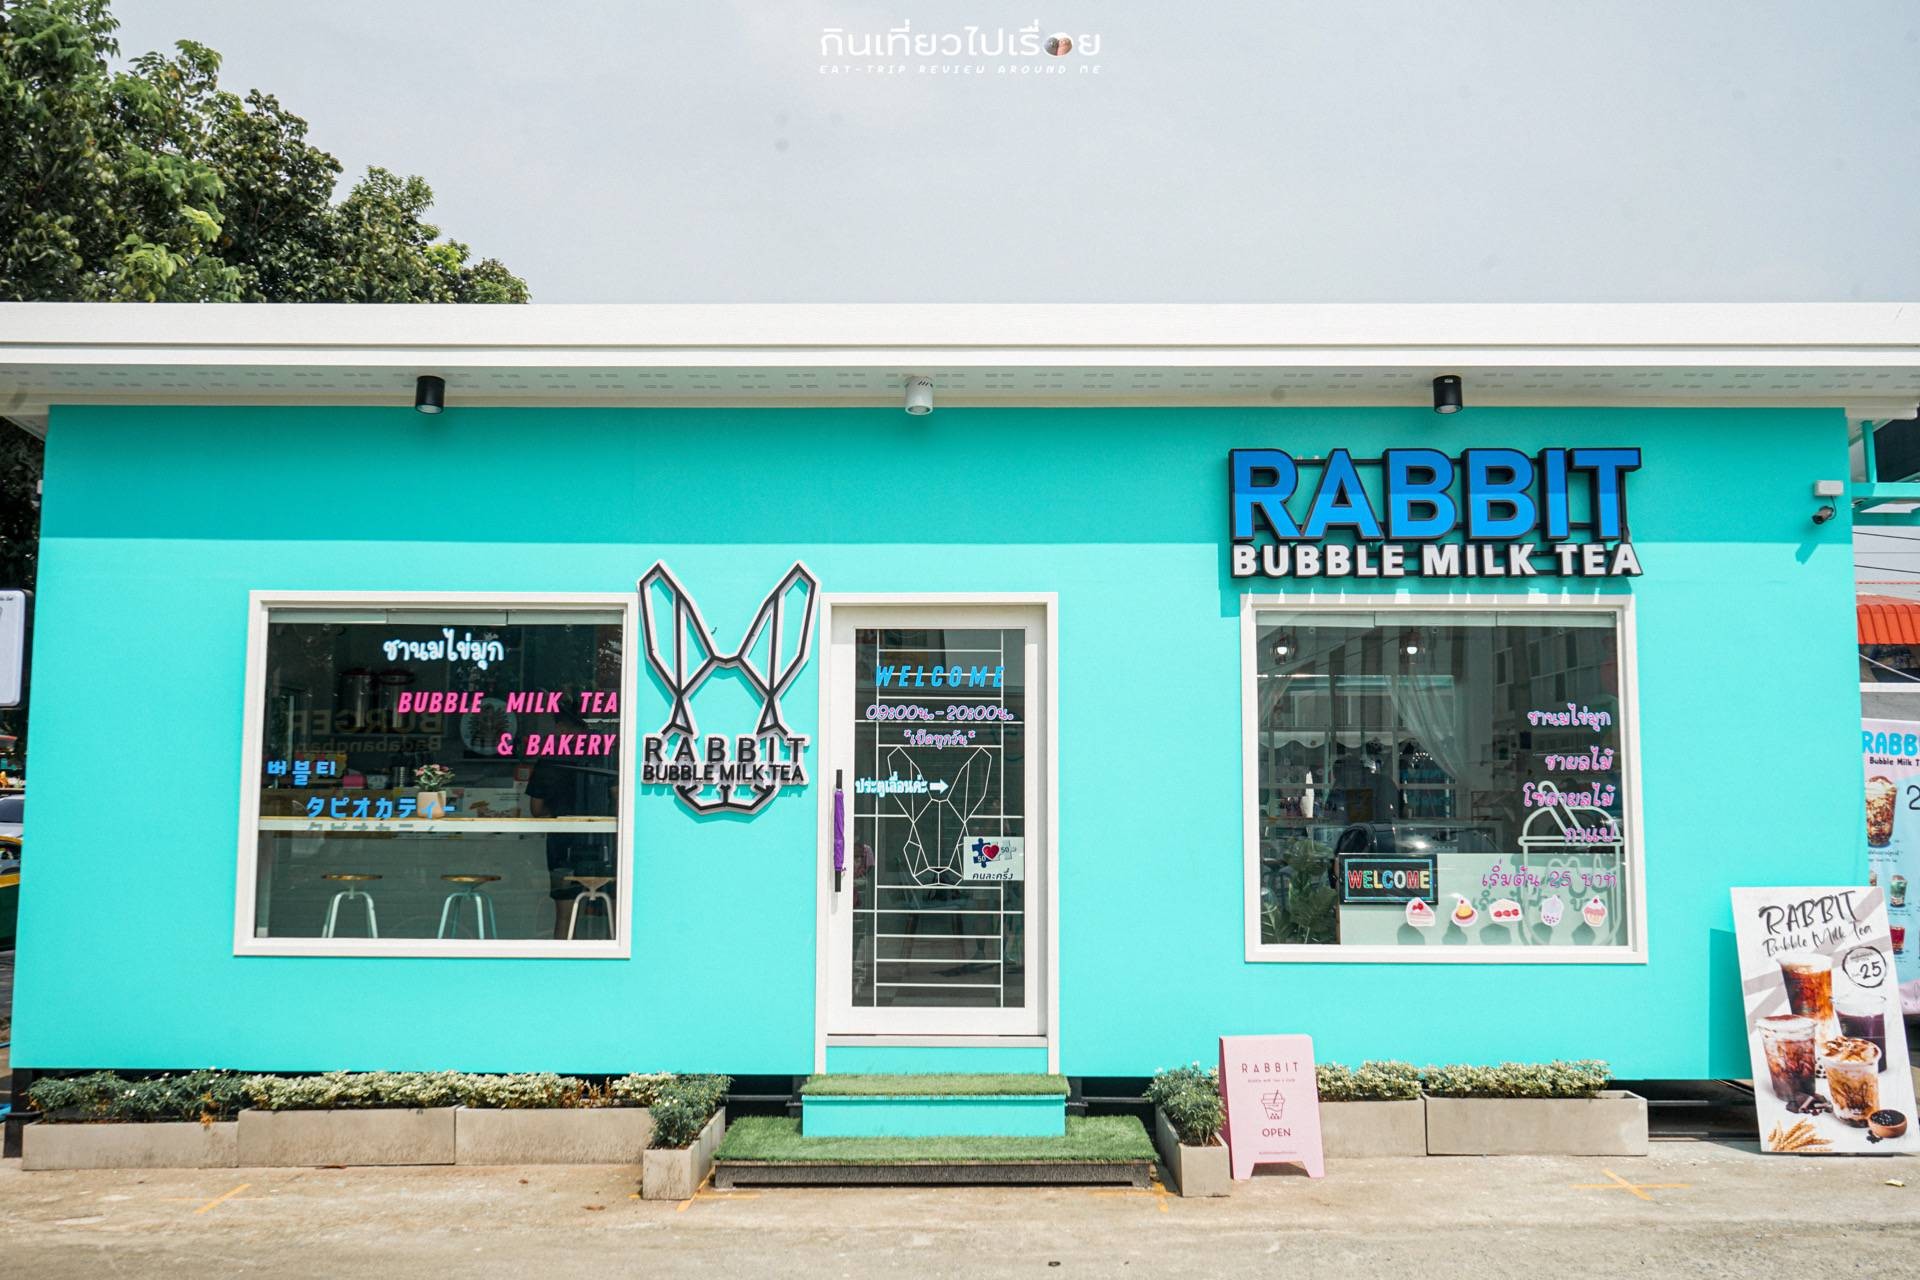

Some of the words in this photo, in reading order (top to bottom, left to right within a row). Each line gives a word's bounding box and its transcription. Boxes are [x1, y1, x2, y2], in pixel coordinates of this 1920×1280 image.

[1230, 448, 1642, 541] RABBIT
[1231, 544, 1406, 577] BUBBLE
[1422, 544, 1537, 577] MILK
[1553, 543, 1642, 577] TEA
[383, 628, 504, 670] ชานมไข่มุก
[875, 665, 1005, 688] WELCOME
[397, 691, 484, 713] BUBBLE
[506, 691, 562, 713] MILK
[580, 691, 618, 713] TEA
[1527, 702, 1611, 732] ชานมไข่มุก
[497, 732, 513, 755] &
[526, 733, 616, 755] BAKERY
[644, 737, 805, 763] RABBIT
[1545, 745, 1614, 771] ชาผลไม้
[1869, 756, 1894, 765] Bubble
[1896, 758, 1912, 766] Milk
[267, 760, 336, 786] 버블티
[643, 764, 714, 781] BUBBLE
[719, 764, 764, 781] MILK
[769, 764, 804, 781] TEA
[855, 771, 928, 798] ประตูเลื่อนค่ะ
[1523, 782, 1616, 807] โซดาผลไม้
[306, 797, 456, 819] タピオカティー
[972, 867, 1013, 879] คนละครึ่ง
[1347, 870, 1430, 889] WELCOME
[1481, 857, 1540, 887] เริ่มต้น
[1550, 870, 1572, 887] 25
[1580, 871, 1617, 887] บาท
[1758, 890, 1856, 935] RABBIT
[1762, 935, 1807, 957] Bubble
[1812, 926, 1846, 949] Milk
[1850, 920, 1873, 941] Tea
[1860, 960, 1882, 980] 25
[1241, 1062, 1299, 1073] RABBIT
[1262, 1127, 1291, 1138] OPEN
